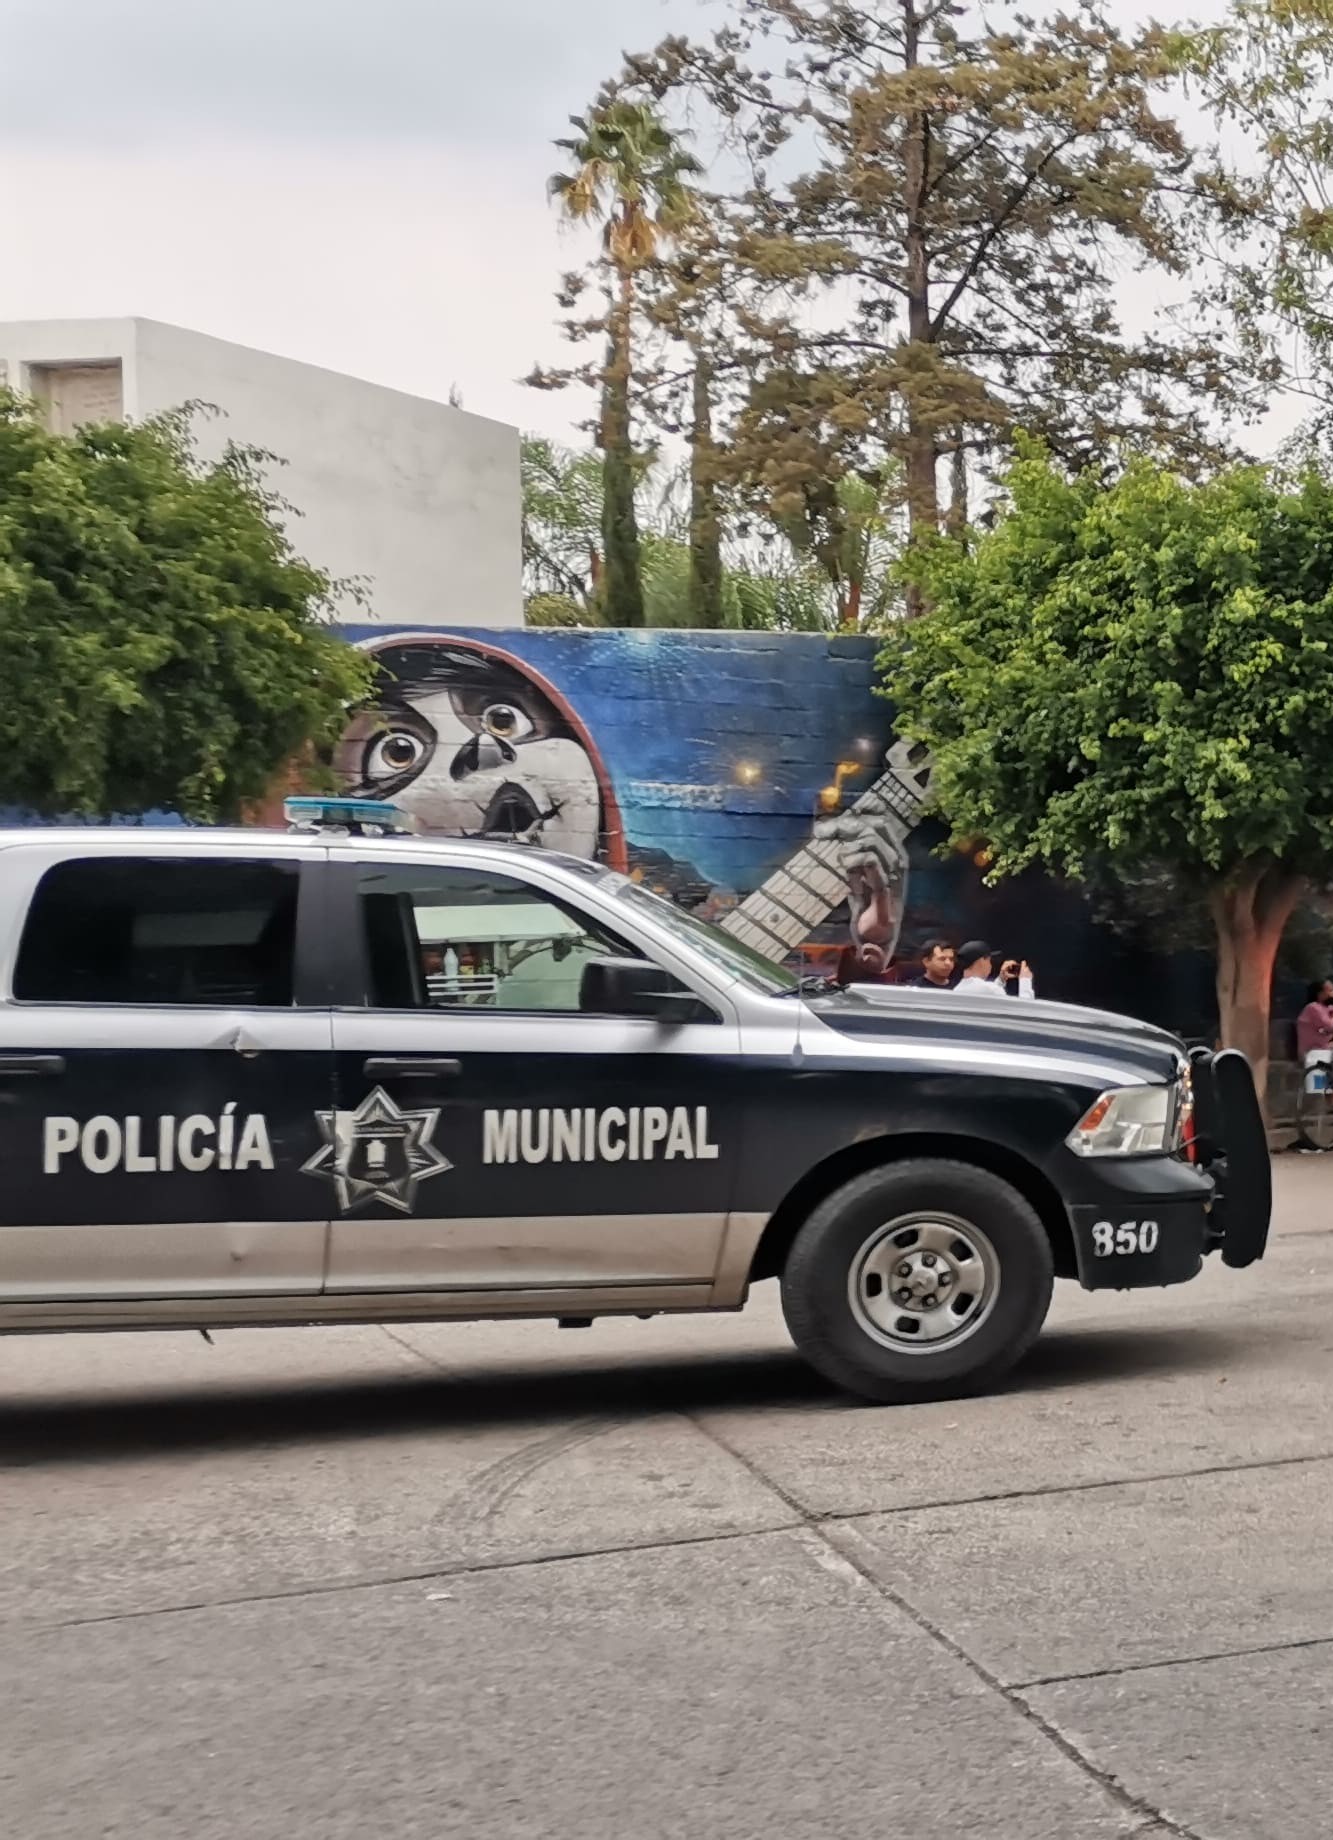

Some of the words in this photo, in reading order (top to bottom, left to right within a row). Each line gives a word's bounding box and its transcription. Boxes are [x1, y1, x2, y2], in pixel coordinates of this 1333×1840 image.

[43, 1101, 275, 1175] POLICÍA
[483, 1106, 719, 1165] MUNICIPAL
[1091, 1221, 1159, 1257] 850
